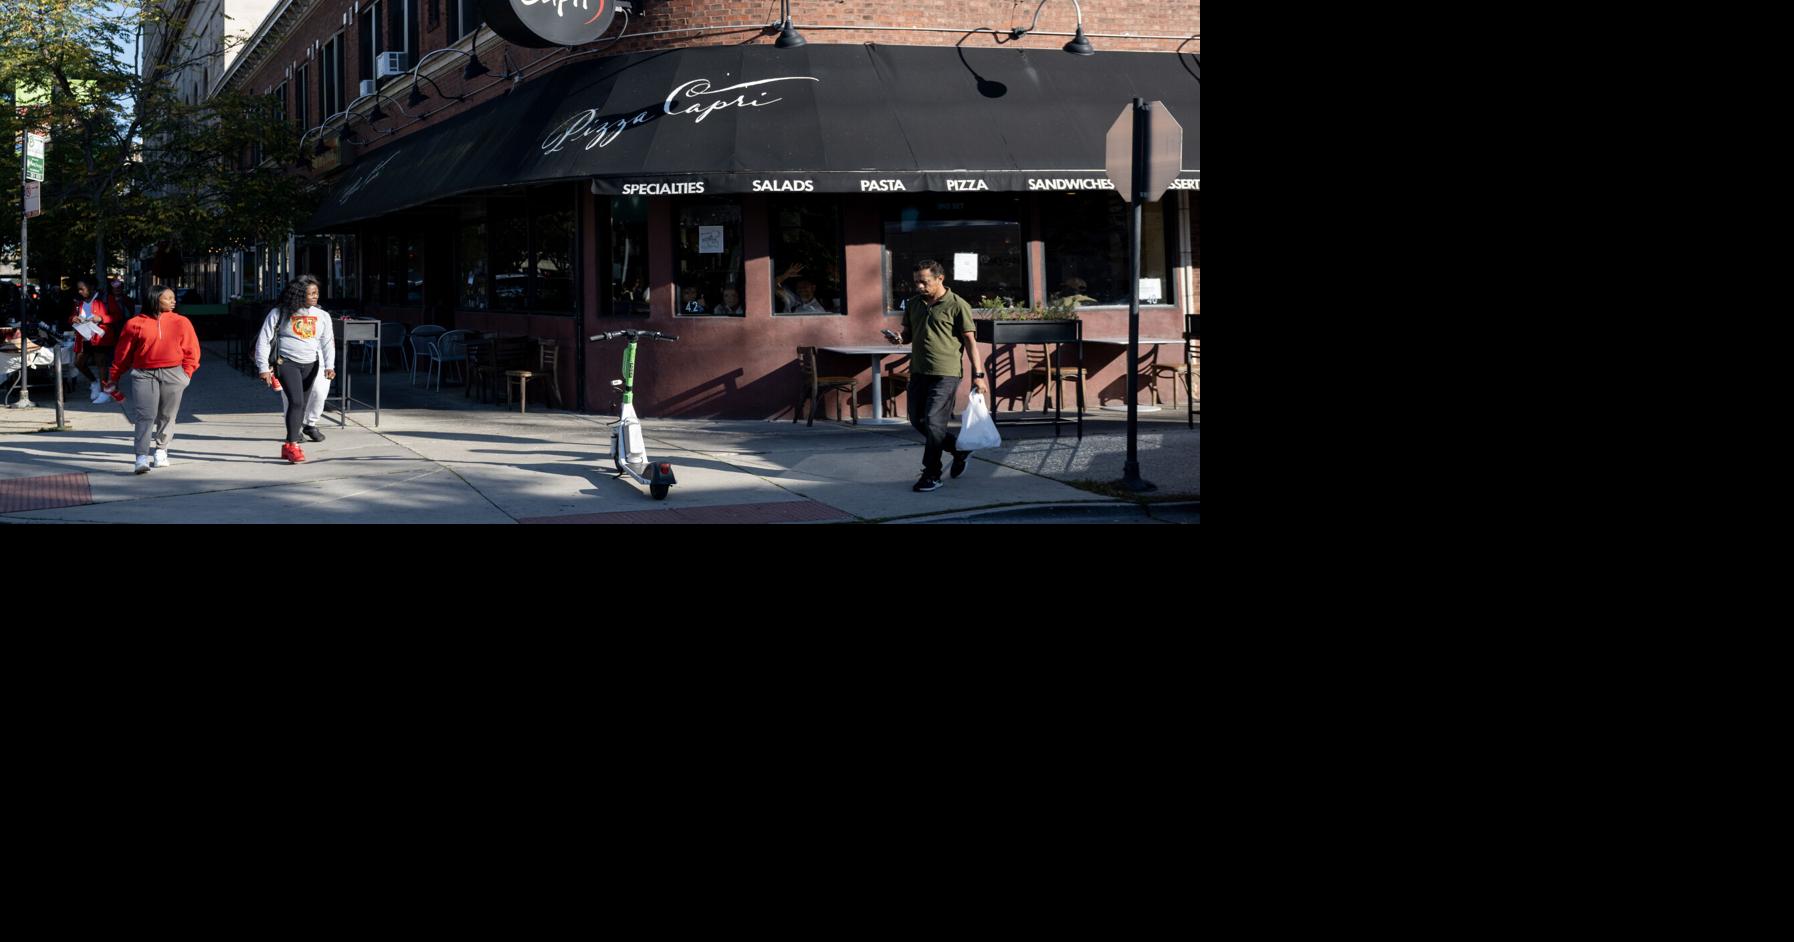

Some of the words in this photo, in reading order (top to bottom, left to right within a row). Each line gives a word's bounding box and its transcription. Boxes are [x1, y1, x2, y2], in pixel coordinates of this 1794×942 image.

[541, 108, 654, 155] Pizza
[663, 76, 820, 124] Capri
[622, 181, 705, 195] SPECIALTIES
[752, 180, 814, 192] SALADS
[860, 179, 906, 192] PASTA
[946, 179, 989, 192] PIZZA
[1028, 178, 1115, 190] SANDWICHES
